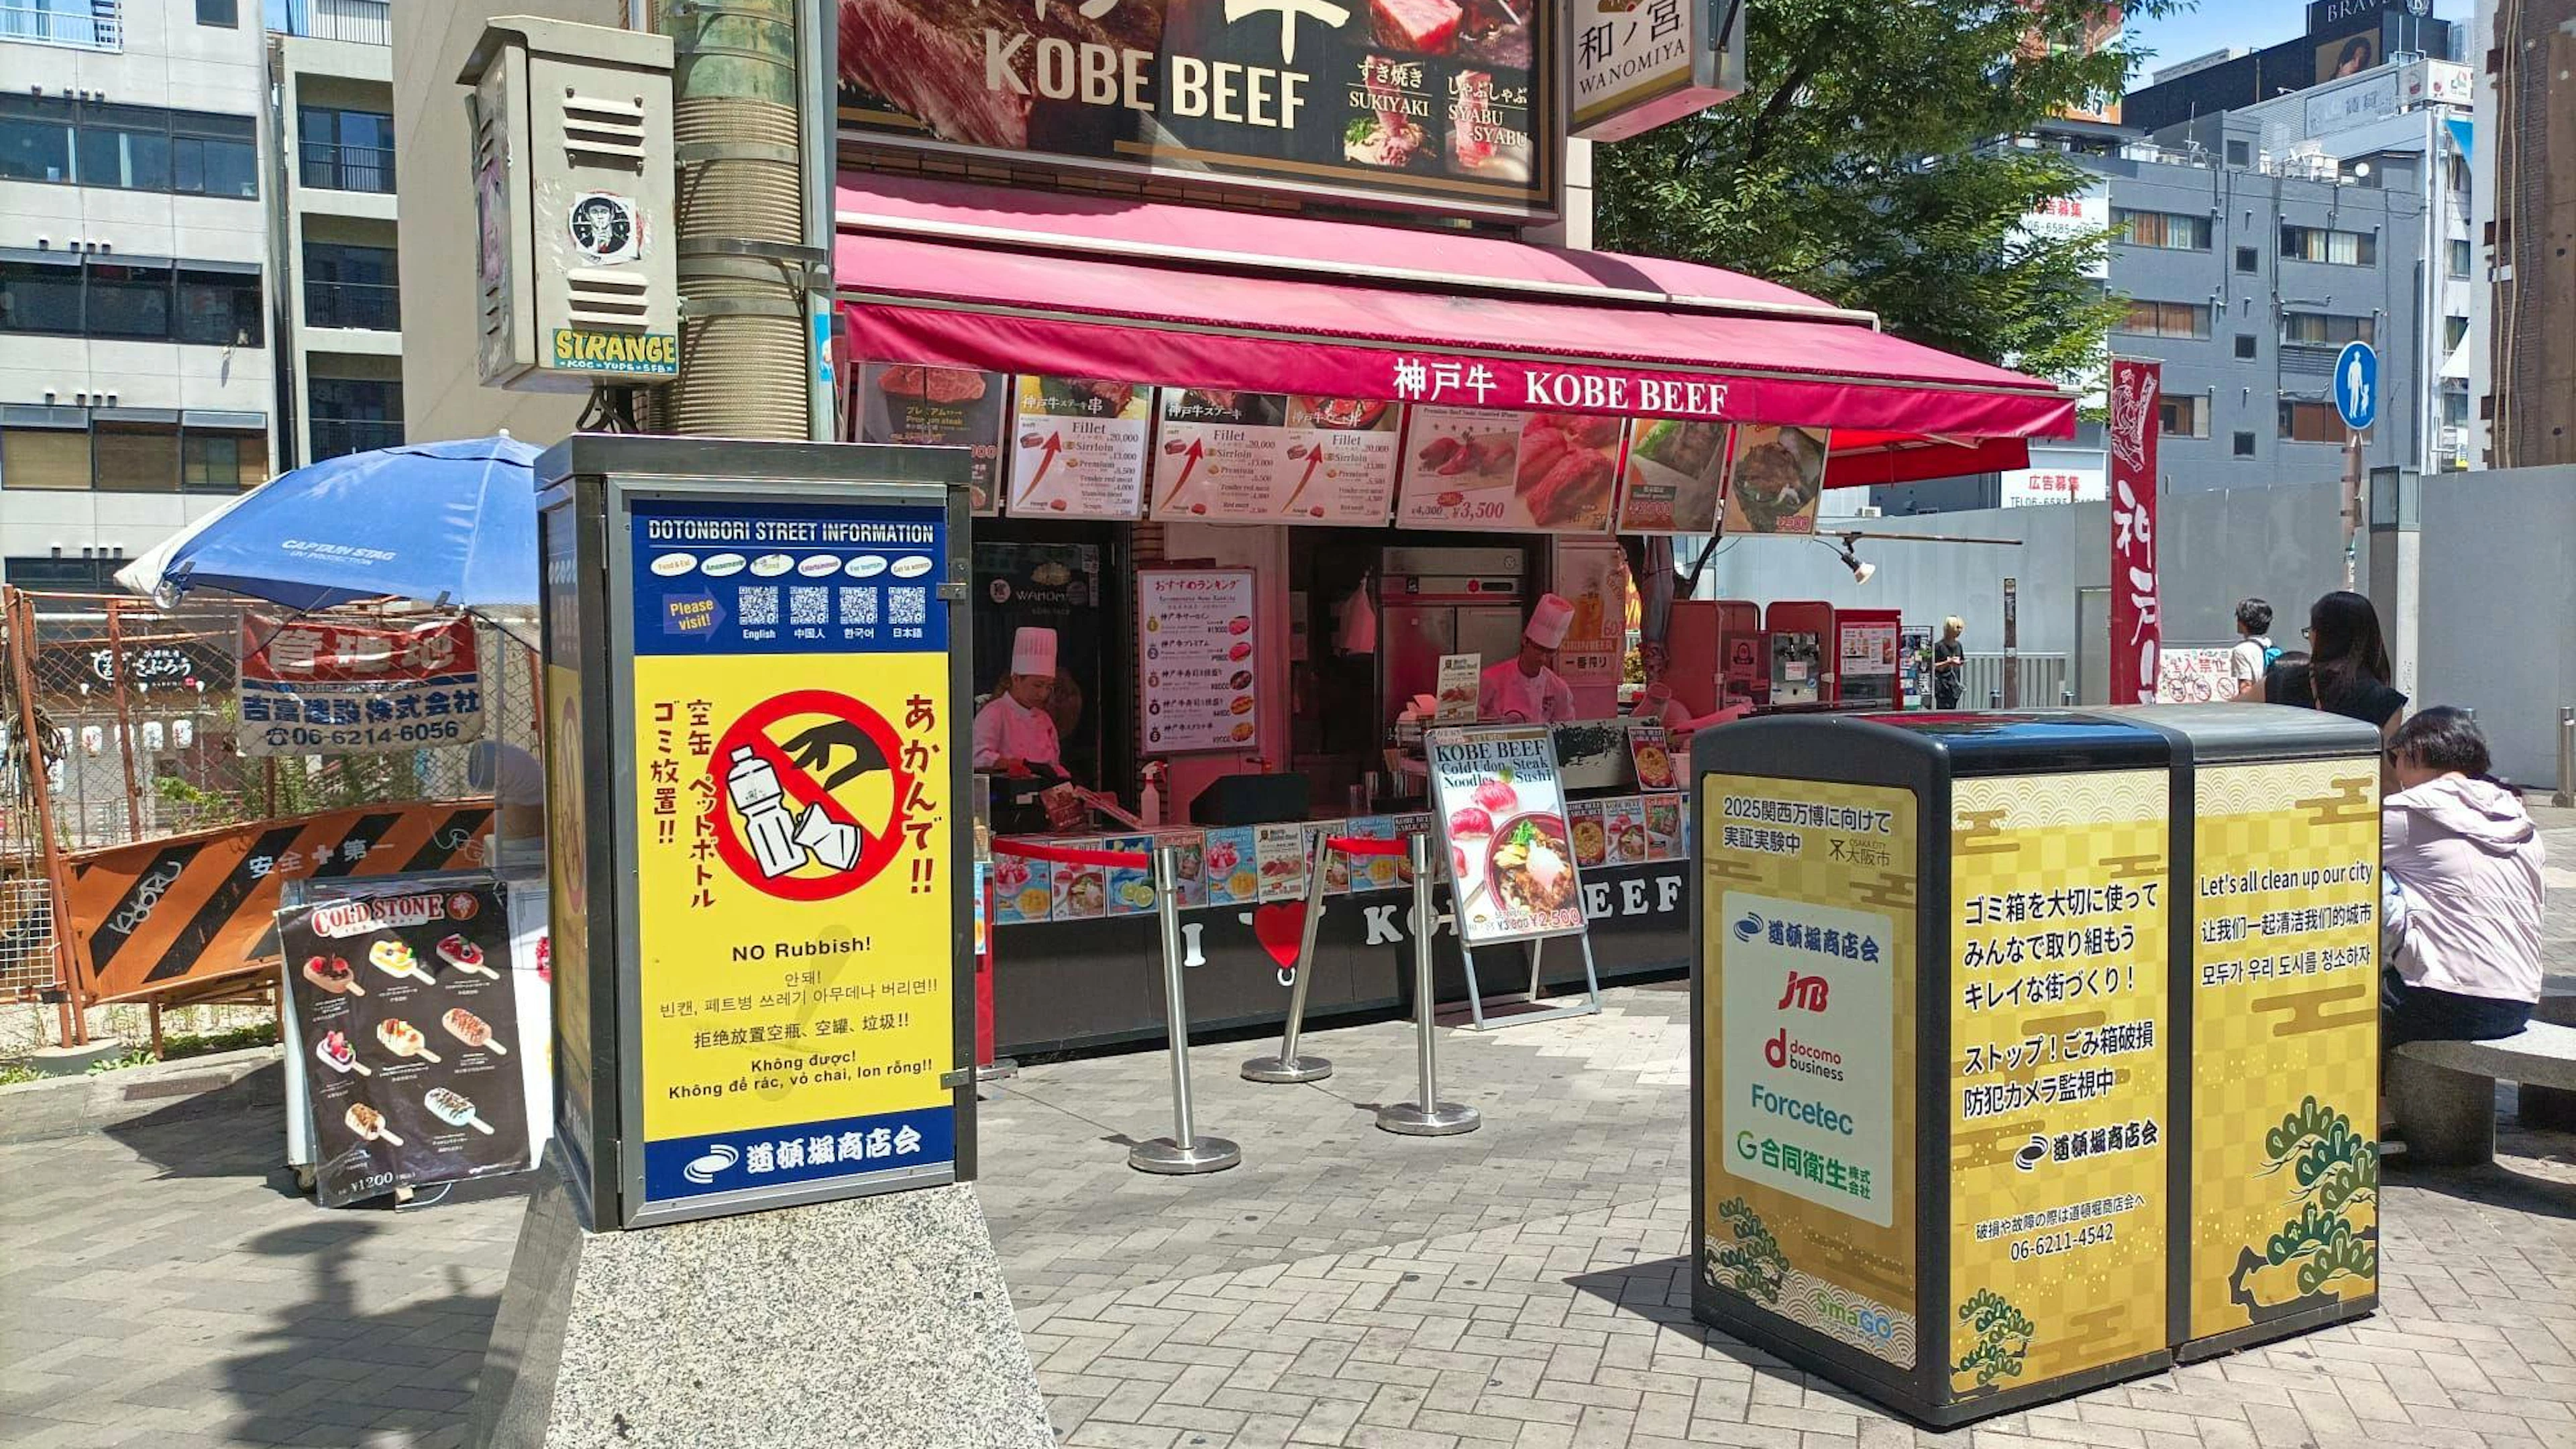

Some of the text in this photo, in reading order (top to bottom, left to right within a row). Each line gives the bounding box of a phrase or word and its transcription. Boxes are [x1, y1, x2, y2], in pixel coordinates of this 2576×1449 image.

[1578, 0, 1680, 70] 和ノ宮
[986, 29, 1155, 111] KOBE
[1172, 55, 1310, 130] BEEF
[1358, 61, 1423, 88] すき焼き
[1579, 39, 1685, 95] WANOMIYA
[1349, 91, 1430, 117] SUKIYAKI
[1448, 76, 1528, 105] しゃぶしゃぶ
[1448, 104, 1505, 126] SYABU
[2035, 197, 2082, 217] 告募集
[556, 329, 676, 363] STRANGE
[1393, 358, 1729, 415] 神戸牛 KOBE BEEF
[1073, 422, 1106, 435] Fillet
[1214, 430, 1245, 441] Fillet
[1332, 435, 1361, 445] Fillet
[1452, 502, 1505, 520] ¥3,500
[649, 519, 934, 543] DOTONBORI STREET INFORMATION
[282, 539, 398, 561] CAPTAIN STAG
[670, 599, 714, 616] Please
[678, 615, 711, 631] visit!
[742, 629, 777, 641] English
[794, 628, 826, 639] 中国人
[844, 628, 875, 640] 한국어
[893, 628, 923, 639] 日本語
[291, 720, 461, 745] 06-6214-6056
[1436, 739, 1546, 762] KOBE BEEF
[1512, 757, 1549, 770] Steak
[650, 699, 681, 845] ゴミ放置!!
[1442, 759, 1505, 775] Cold Udon
[1444, 773, 1496, 789] Noodles
[1515, 769, 1552, 784] Sushi
[686, 699, 716, 908] 空缶 ペットボトル
[903, 694, 942, 894] あかんで!!
[1723, 796, 1892, 834] 2025関西万博に向けて
[1723, 826, 1801, 854] 実証実験中
[248, 837, 394, 879] 安全 第一
[1845, 847, 1892, 867] 大阪市
[2201, 861, 2373, 896] Let's all clean up our city
[1583, 875, 1682, 920] EEF
[1965, 882, 2158, 925] ゴミ箱を大切に使って
[313, 902, 370, 937] COLD
[373, 895, 443, 920] STONE
[2202, 902, 2372, 943] 让我们一起清洁我们的城市
[733, 936, 871, 961] NO Rubbish!
[1768, 919, 1881, 963] 道頓堀商店会
[1964, 924, 2135, 968] みんなで取り組もう
[784, 970, 822, 987] 안돼!
[2202, 944, 2371, 986] 모두가 우리 도시를 청소하자
[659, 978, 938, 1018] 빈캔, 페트병 쓰레기 아무데나 버리면!!
[1778, 971, 1829, 1013] JTB
[1964, 965, 2134, 1011] キレイな街づくり！
[751, 1051, 856, 1073] Không được!
[1790, 1038, 1842, 1065] docomo
[1965, 1021, 2153, 1074] ストップ！ごみ箱破損
[669, 1082, 722, 1099] Không
[754, 1075, 784, 1091] rác,
[814, 1067, 852, 1085] chai,
[857, 1065, 881, 1079] lon
[1789, 1057, 1844, 1081] business
[1964, 1068, 2114, 1118] 防犯カメラ監視中
[1752, 1083, 1854, 1136] Forcetec
[745, 1124, 922, 1175] 道頓堀商店会
[2053, 1119, 2159, 1163] 道頓堀商店会
[1760, 1138, 1847, 1191] 合同衛生
[350, 1171, 393, 1193] ¥1200
[1976, 1194, 2145, 1240] 破損や故障の際は道頓堀商店会へ
[2010, 1224, 2114, 1262] 06-6211-4542
